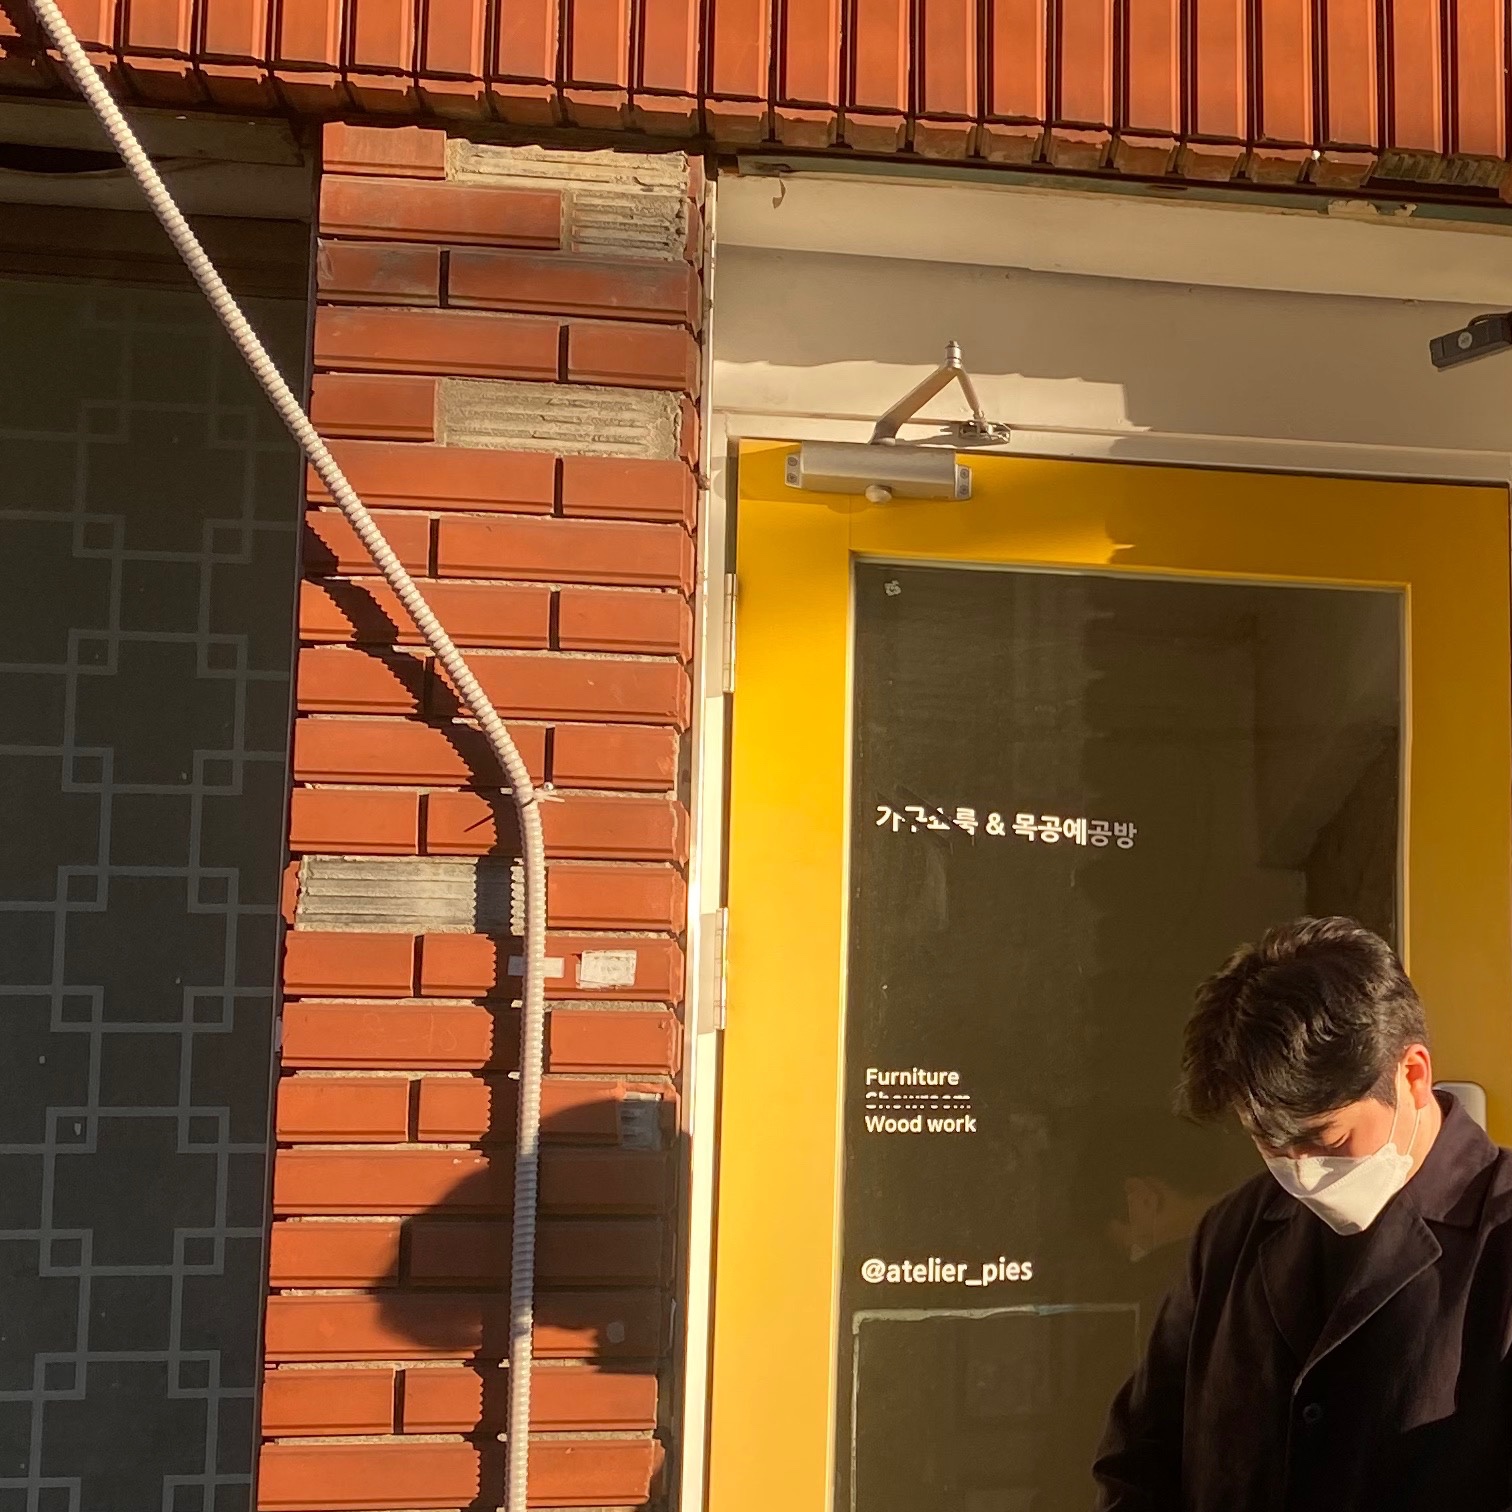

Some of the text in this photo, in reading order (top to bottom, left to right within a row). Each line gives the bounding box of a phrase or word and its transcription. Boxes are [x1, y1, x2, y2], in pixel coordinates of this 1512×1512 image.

[985, 812, 1006, 836] &
[1012, 813, 1138, 849] 목공예공방
[865, 1067, 960, 1086] Furniture
[864, 1114, 977, 1133] Wood work
[861, 1256, 1033, 1287] @atelier_pies
